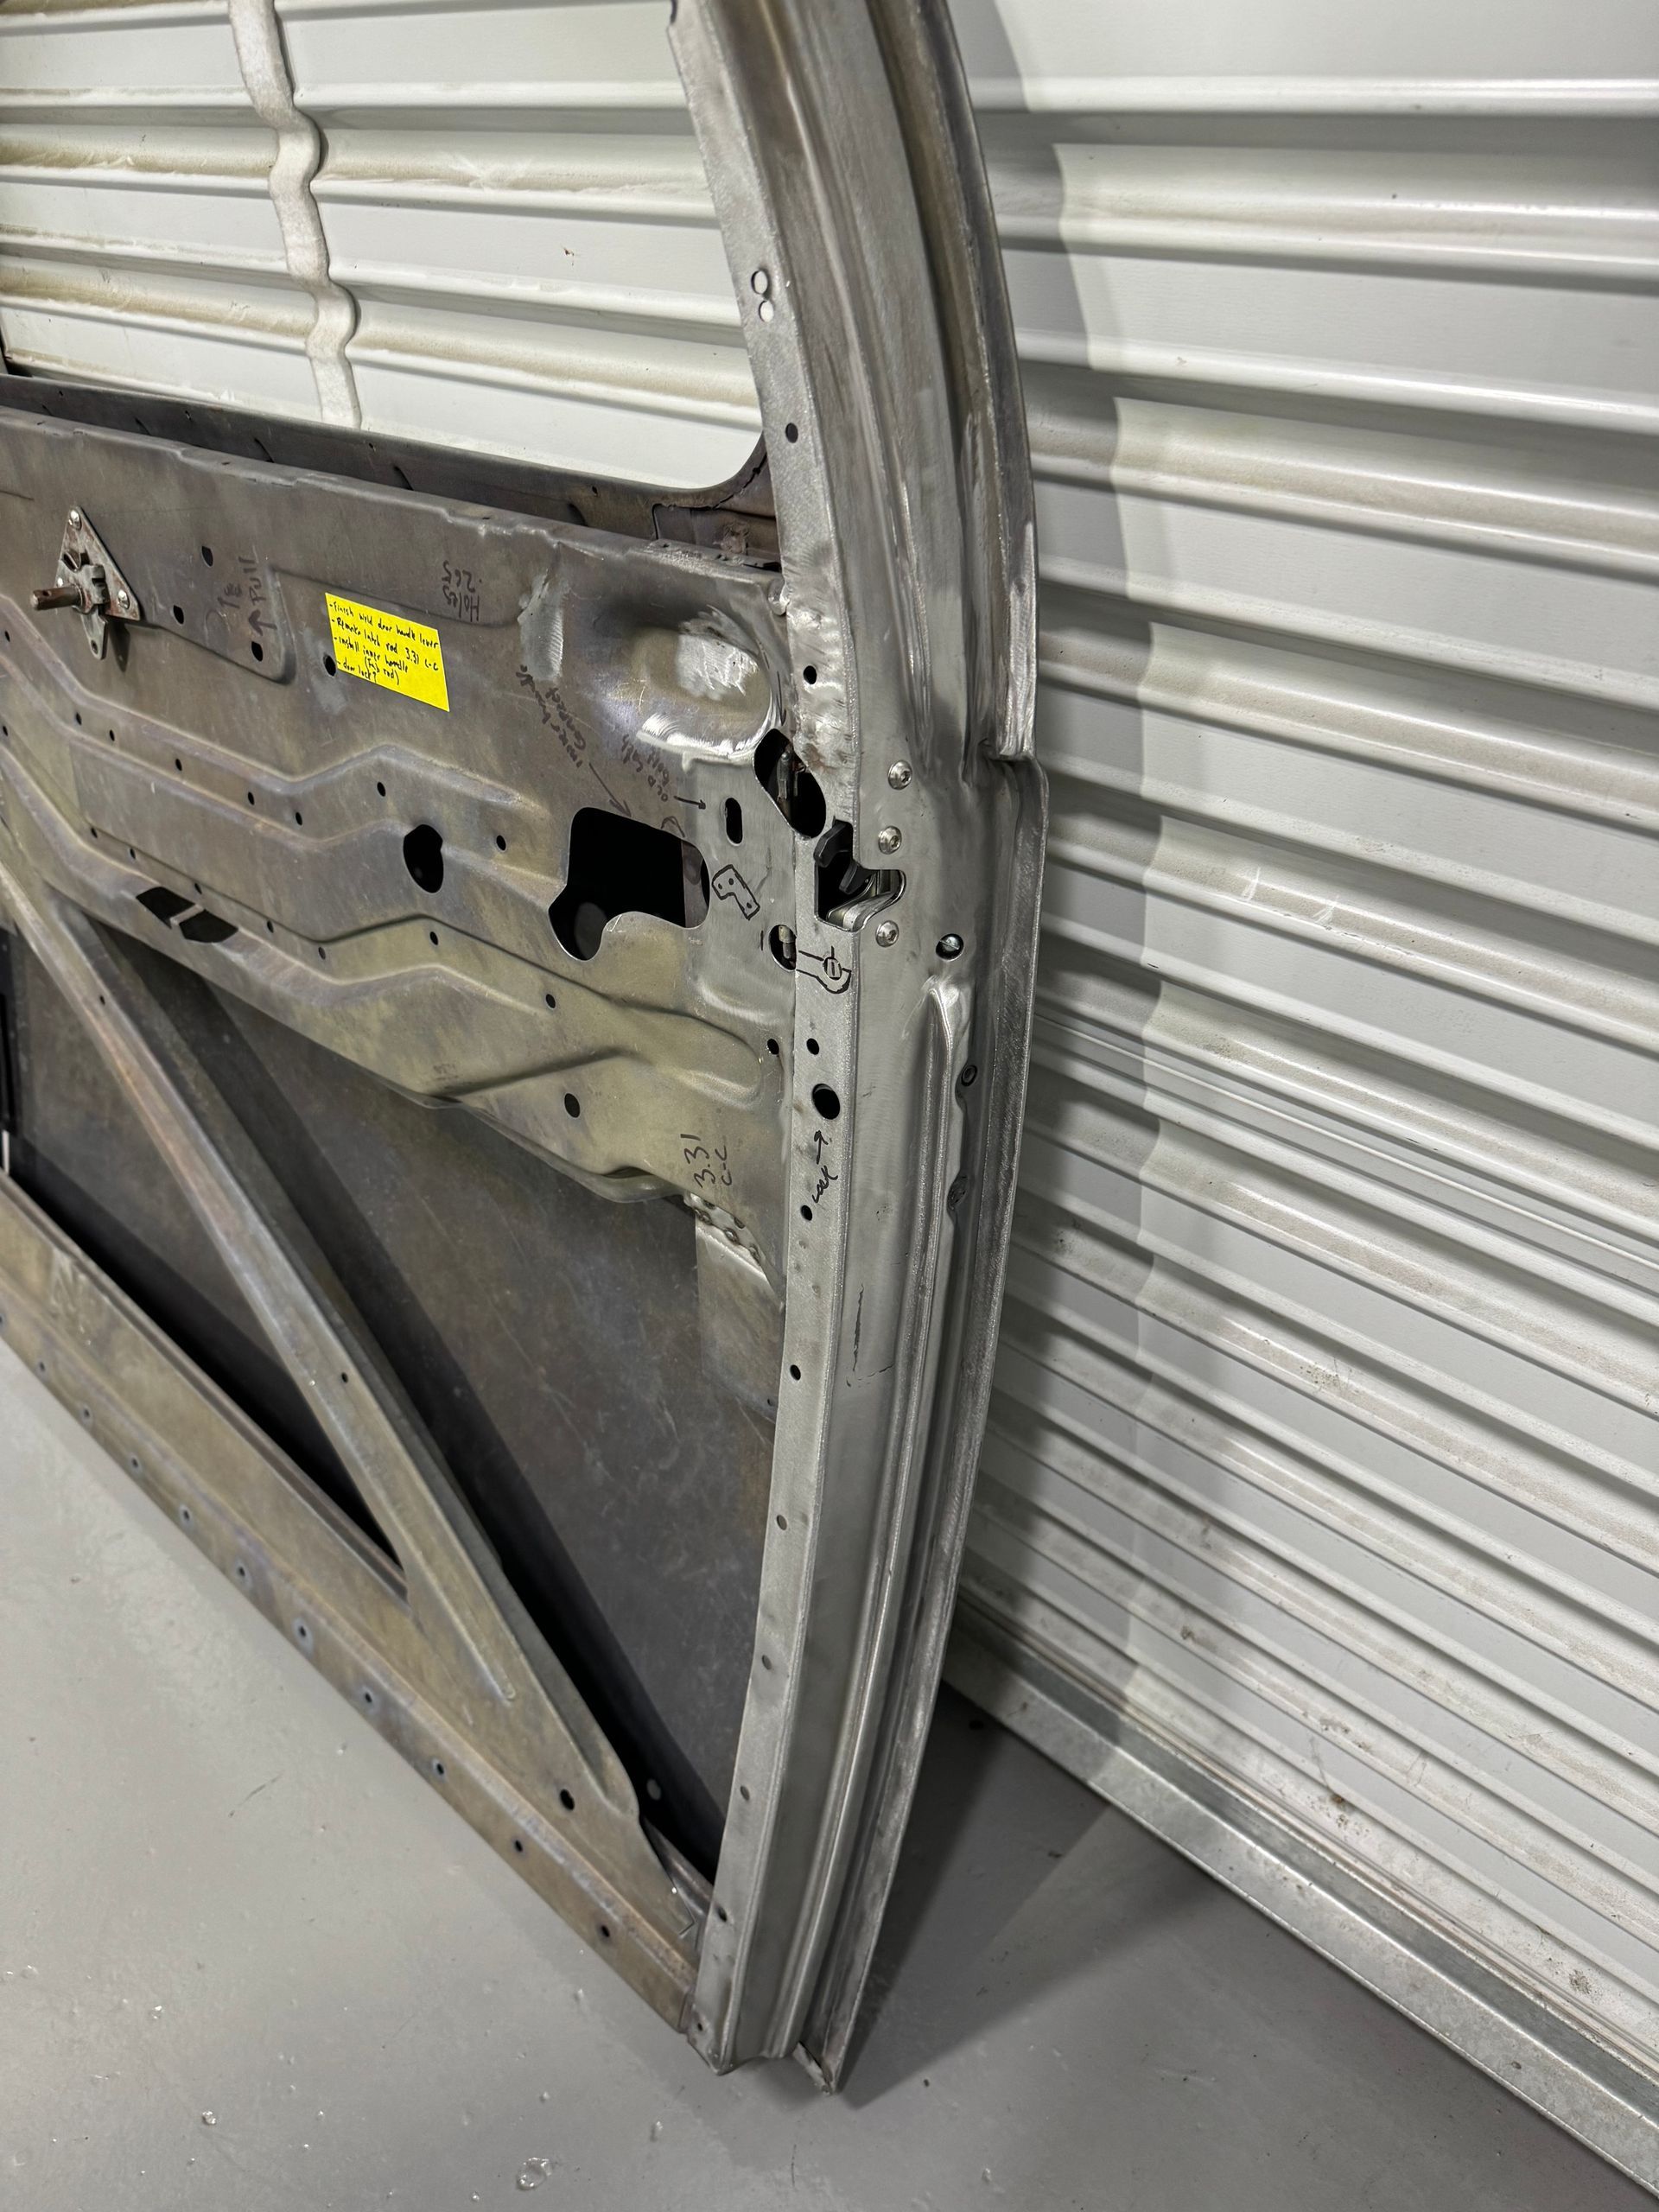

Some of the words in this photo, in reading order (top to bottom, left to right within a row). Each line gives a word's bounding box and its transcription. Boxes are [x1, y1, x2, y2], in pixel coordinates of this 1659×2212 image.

[442, 585, 480, 622] Holes
[385, 642, 398, 654] rod
[680, 1133, 716, 1189] 3.31
